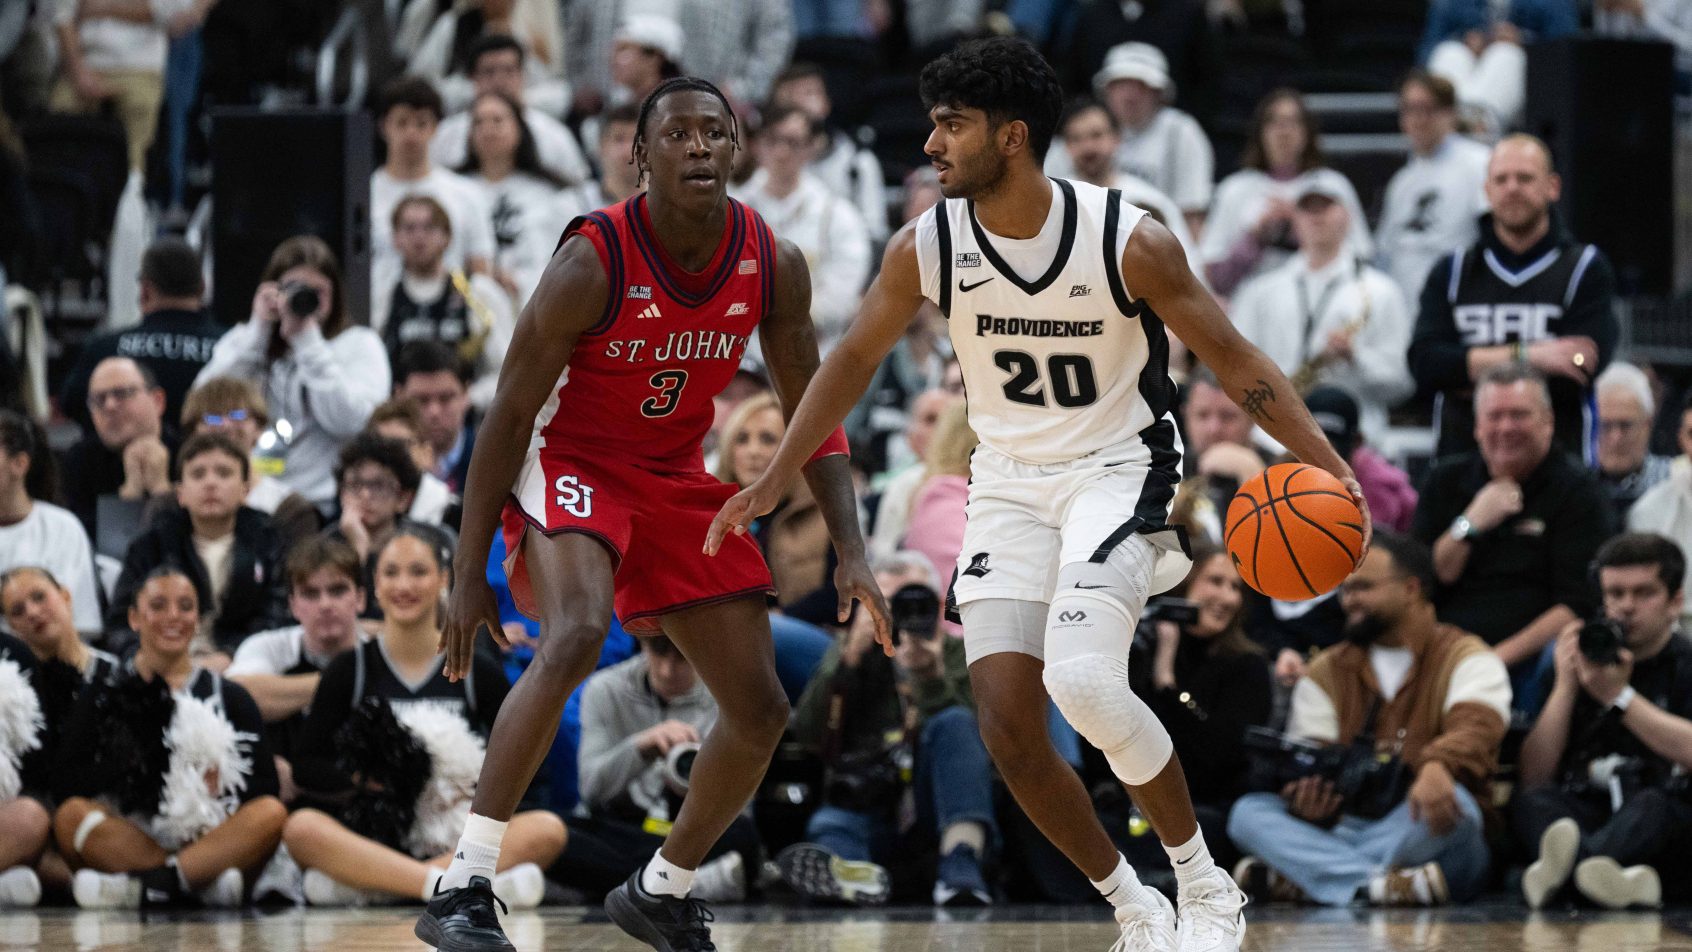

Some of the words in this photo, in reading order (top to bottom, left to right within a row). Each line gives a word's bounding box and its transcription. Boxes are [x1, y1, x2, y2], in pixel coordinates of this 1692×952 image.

[975, 314, 1104, 337] PROVIDENCE
[605, 339, 646, 362] ST.
[640, 369, 689, 419] 3
[991, 348, 1100, 409] 20
